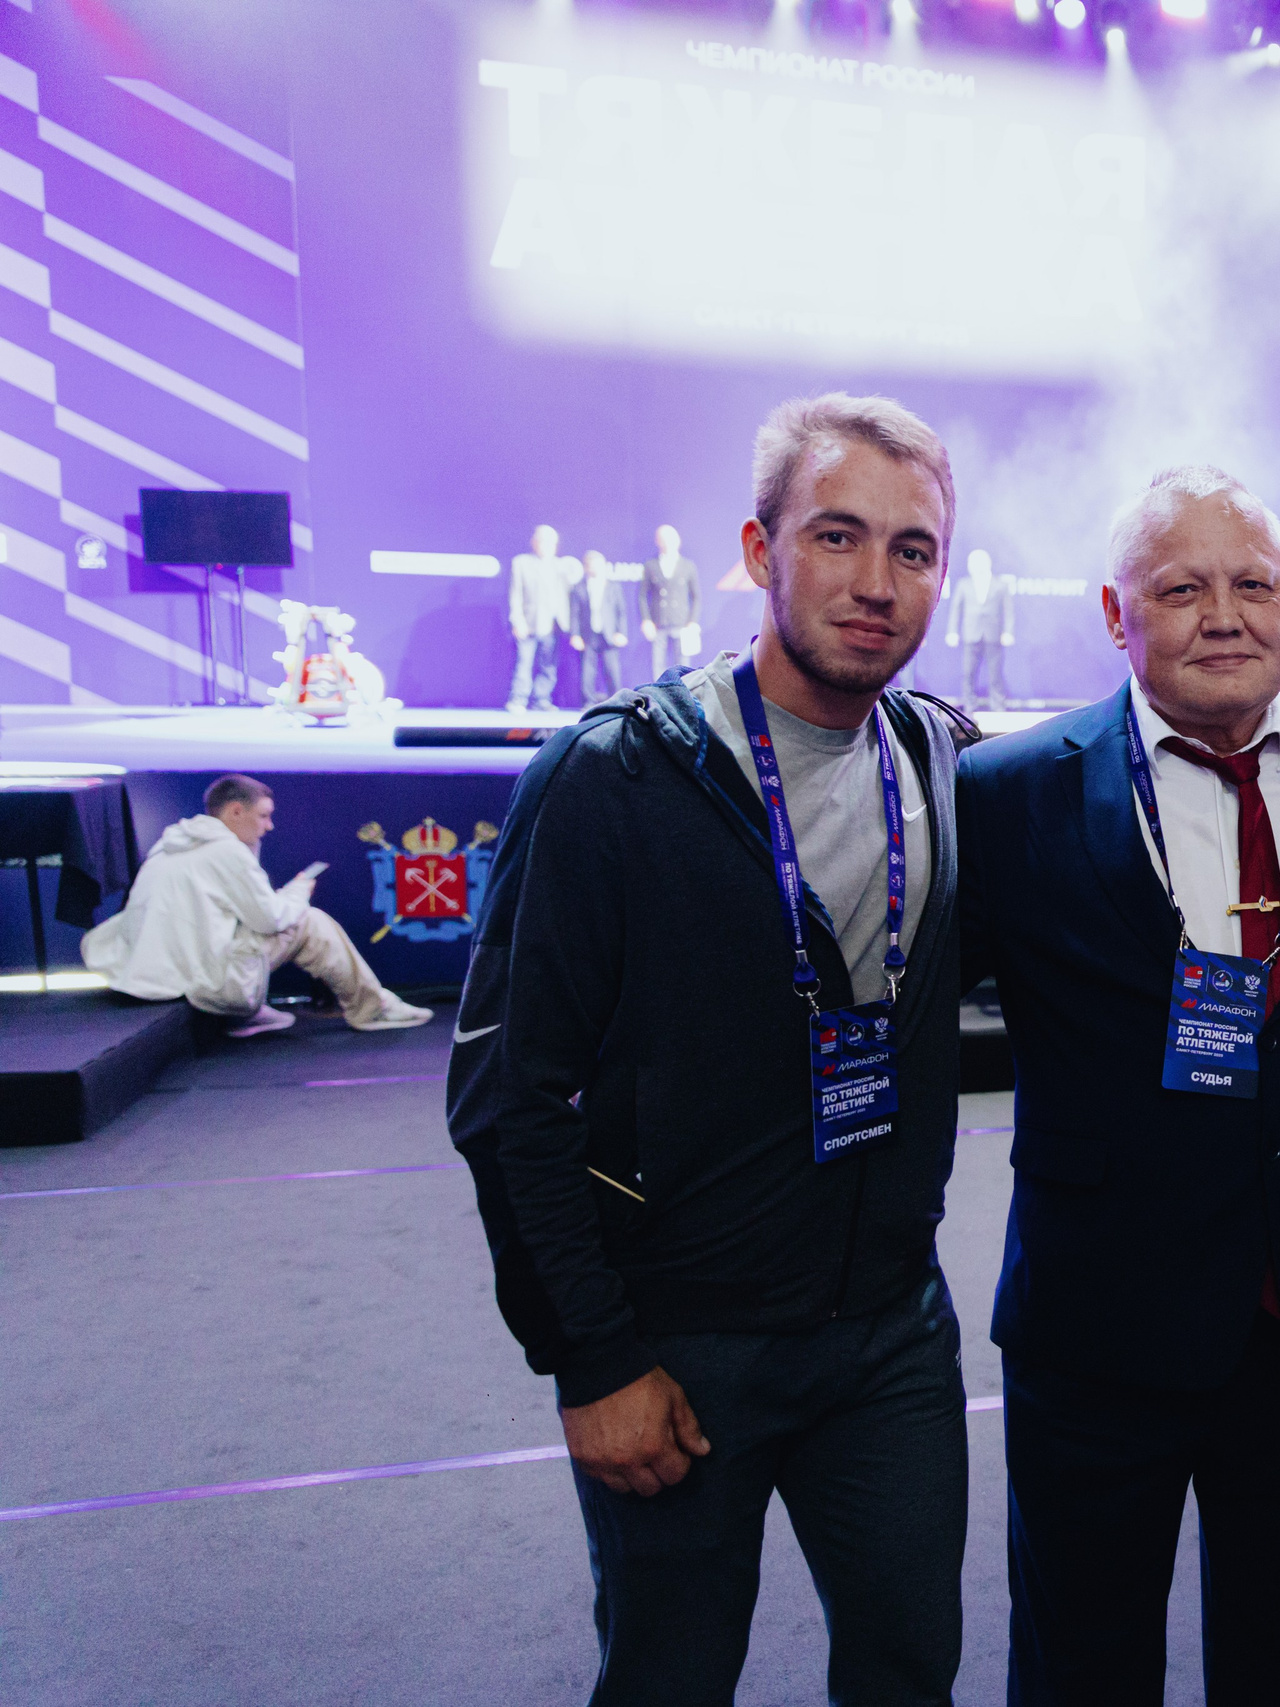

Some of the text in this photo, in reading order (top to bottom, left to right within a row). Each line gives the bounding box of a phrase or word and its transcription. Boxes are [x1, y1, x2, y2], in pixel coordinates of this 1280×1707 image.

[685, 39, 975, 98] ЧЕМПИОНАТ РОССИИ
[478, 59, 1146, 221] ТЯЖЕЛАЯ
[774, 806, 787, 851] МАРАФОН
[787, 872, 798, 909] ТЯЖЕЛОЙ
[792, 910, 803, 944] АТЛЕТИКЕ
[1198, 1002, 1257, 1018] МАРАФОН
[1177, 1025, 1254, 1044] ПО ТЯЖЕЛОЙ
[1179, 1018, 1238, 1031] ЧЕМПИОНАТ РОССИИ
[1176, 1036, 1235, 1053] АТЛЕТИКЕ
[837, 1052, 889, 1073] МАРАФОН
[821, 1075, 875, 1093] ЧЕМПИОНАТ РОССИИ
[822, 1076, 890, 1104] ПО ТЯЖЕЛОЙ
[1191, 1071, 1232, 1086] СУДЬЯ
[822, 1093, 875, 1117] АТЛЕТИКЕ
[823, 1122, 892, 1151] СПОРТСМЕН
